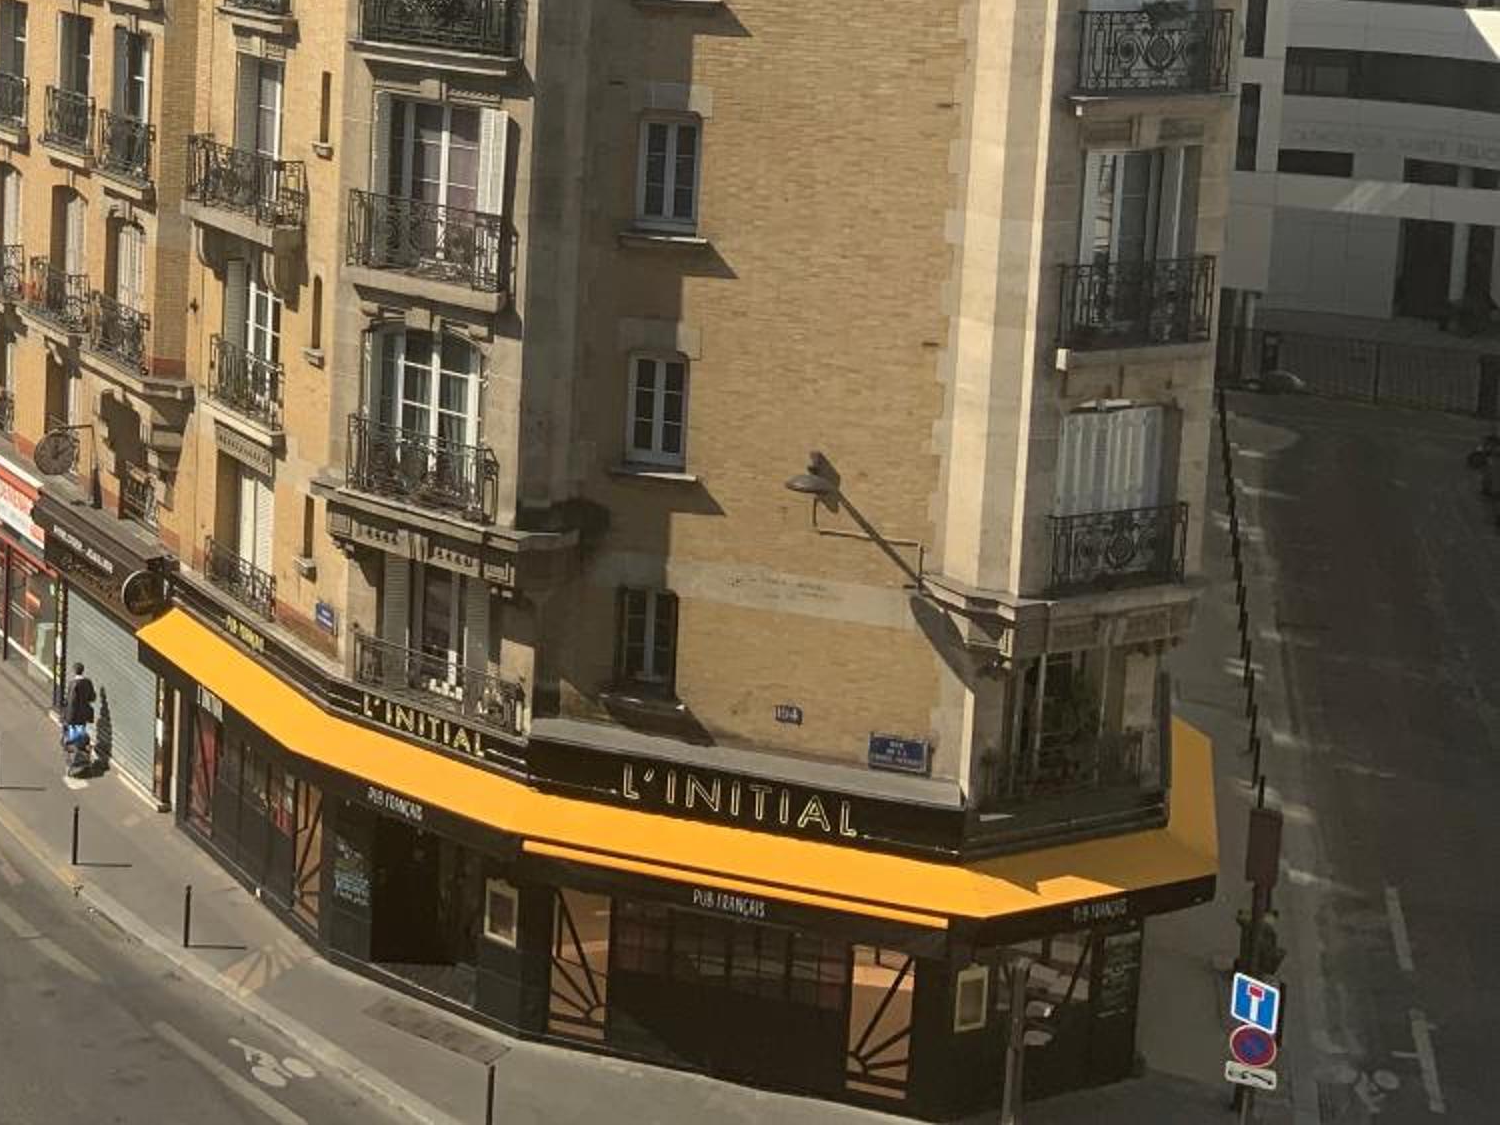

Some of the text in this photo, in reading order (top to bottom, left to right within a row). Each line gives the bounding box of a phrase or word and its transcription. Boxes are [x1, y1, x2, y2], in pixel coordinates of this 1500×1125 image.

[363, 692, 485, 757] L'INITIAL
[622, 762, 858, 839] L'INITIAL
[693, 888, 715, 909] PUB
